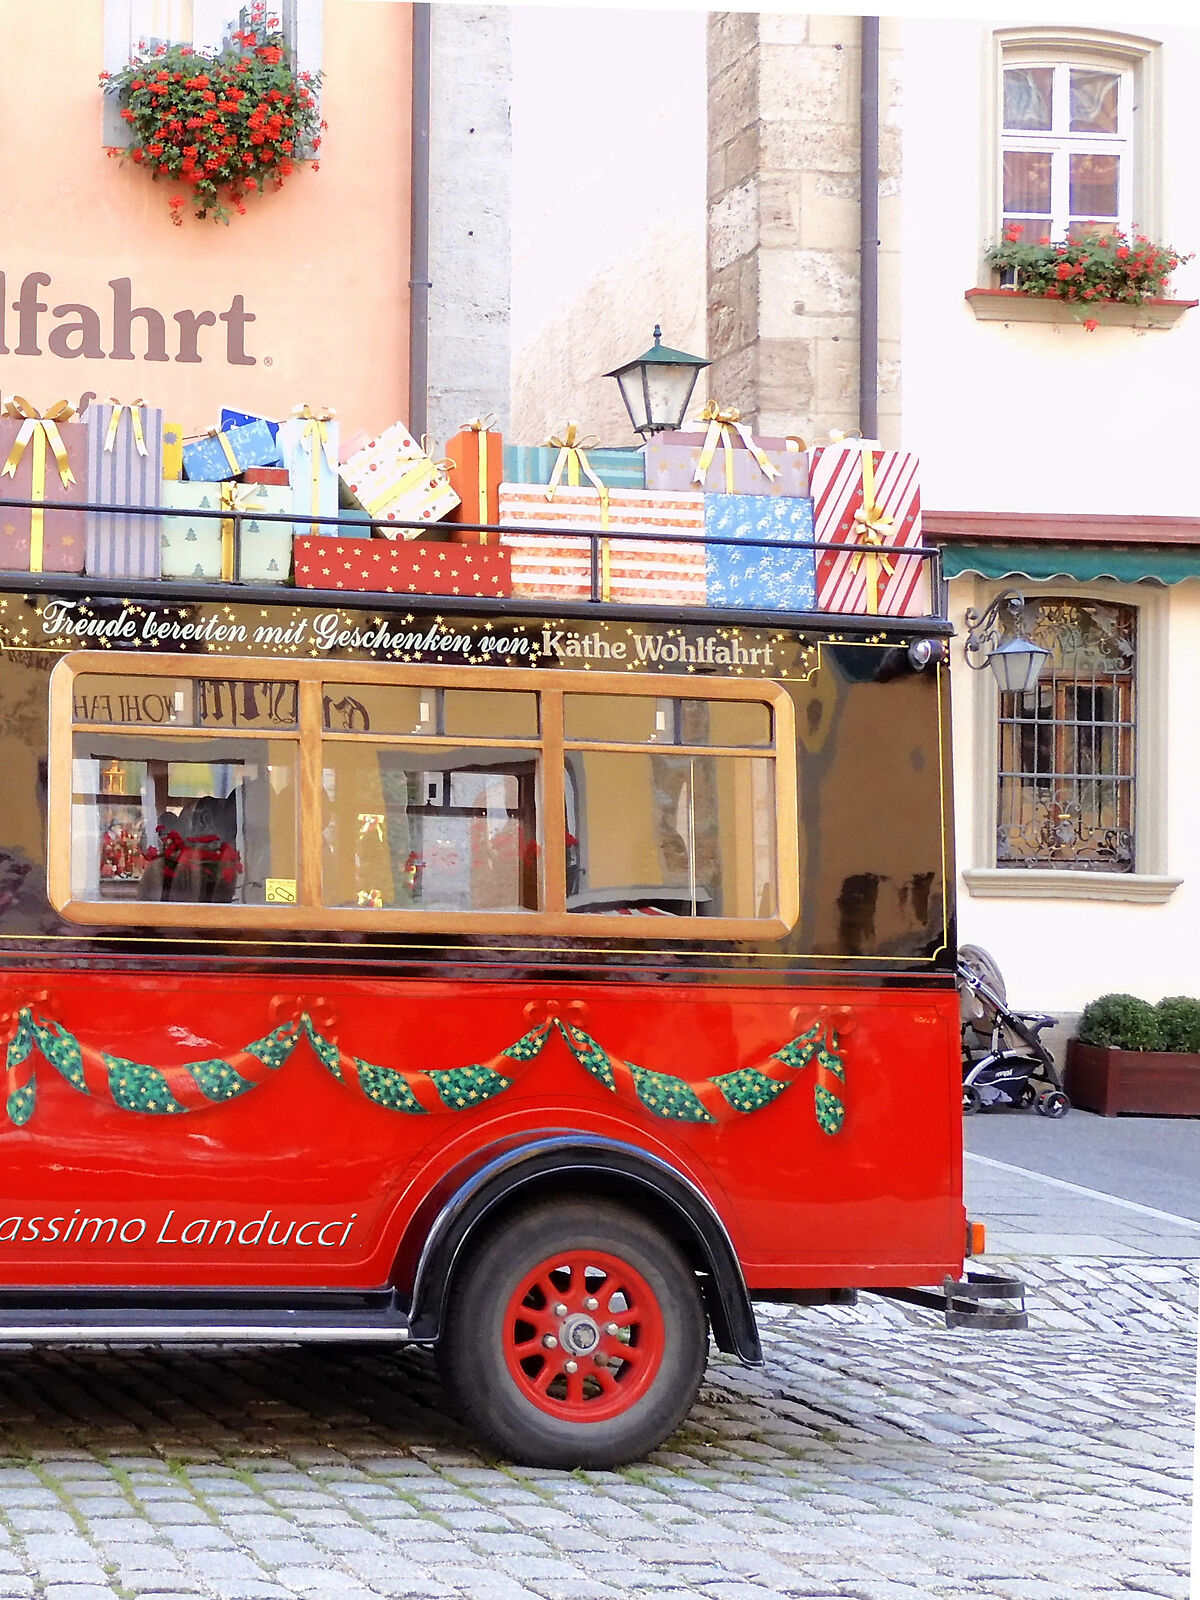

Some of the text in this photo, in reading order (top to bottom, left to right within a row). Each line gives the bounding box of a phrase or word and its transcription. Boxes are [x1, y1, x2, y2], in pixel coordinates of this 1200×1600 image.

[42, 600, 774, 667] Freude bereiten mit Geschenken von Käthe Wohlfahrt
